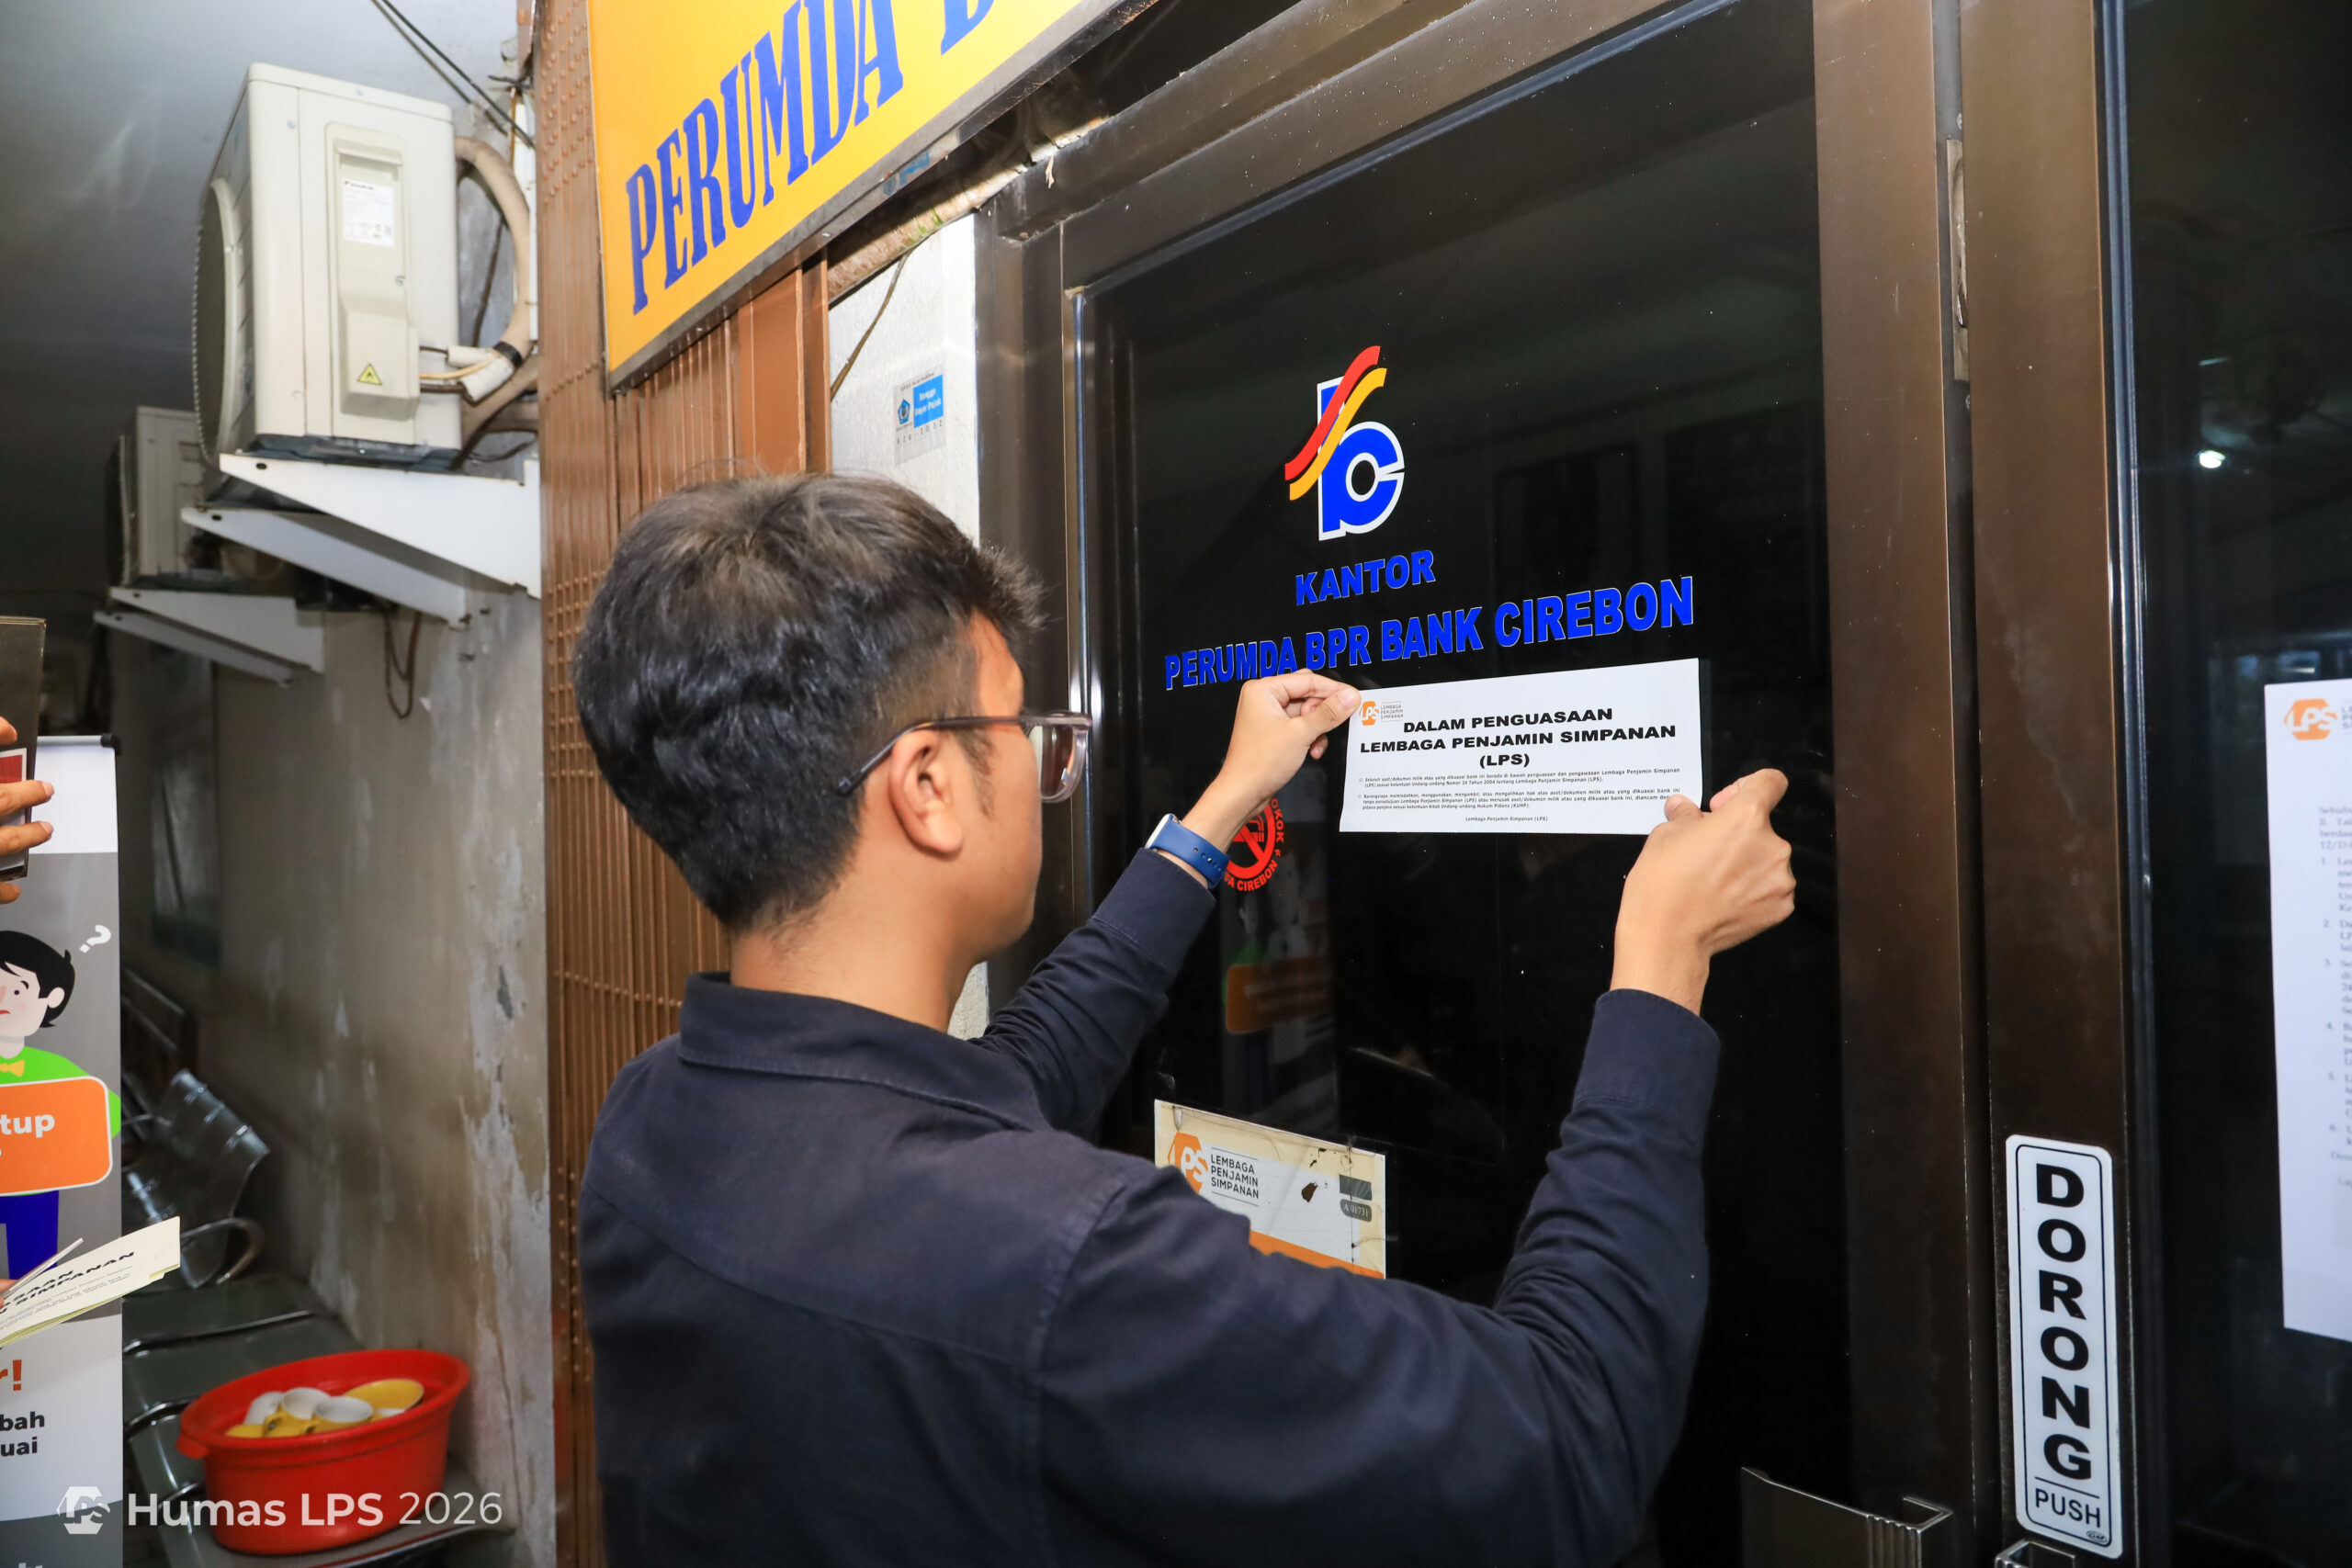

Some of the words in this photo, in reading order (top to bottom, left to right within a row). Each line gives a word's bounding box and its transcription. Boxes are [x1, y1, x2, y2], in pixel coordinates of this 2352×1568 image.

[626, 0, 903, 316] PERUMDA
[1295, 549, 1435, 605] KANTOR
[1165, 637, 1298, 691] PERUMDA
[1306, 625, 1371, 671] BPR
[1381, 606, 1483, 661] BANK
[1495, 576, 1694, 648] CIREBON
[1404, 718, 1465, 733] DALAM
[1472, 708, 1613, 729] PENGUASAAN
[1361, 738, 1446, 753] LEMBAGA
[1452, 732, 1553, 748] PENJAMIN
[1560, 725, 1676, 743] SIMPANAN
[1480, 753, 1530, 769] (LPS)
[1271, 797, 1284, 842] OKOK
[1224, 872, 1235, 888] TA
[1237, 860, 1278, 891] CIREBON
[0, 1114, 55, 1138] tup
[1211, 1154, 1255, 1175] LEMBAGA
[1211, 1166, 1258, 1187] PENJAMIN
[1211, 1177, 1259, 1199] SIMPANAN
[2036, 1163, 2092, 1480] DORONG
[0, 1411, 45, 1431] bah
[0, 1437, 38, 1457] uai
[2035, 1488, 2101, 1529] PUSH
